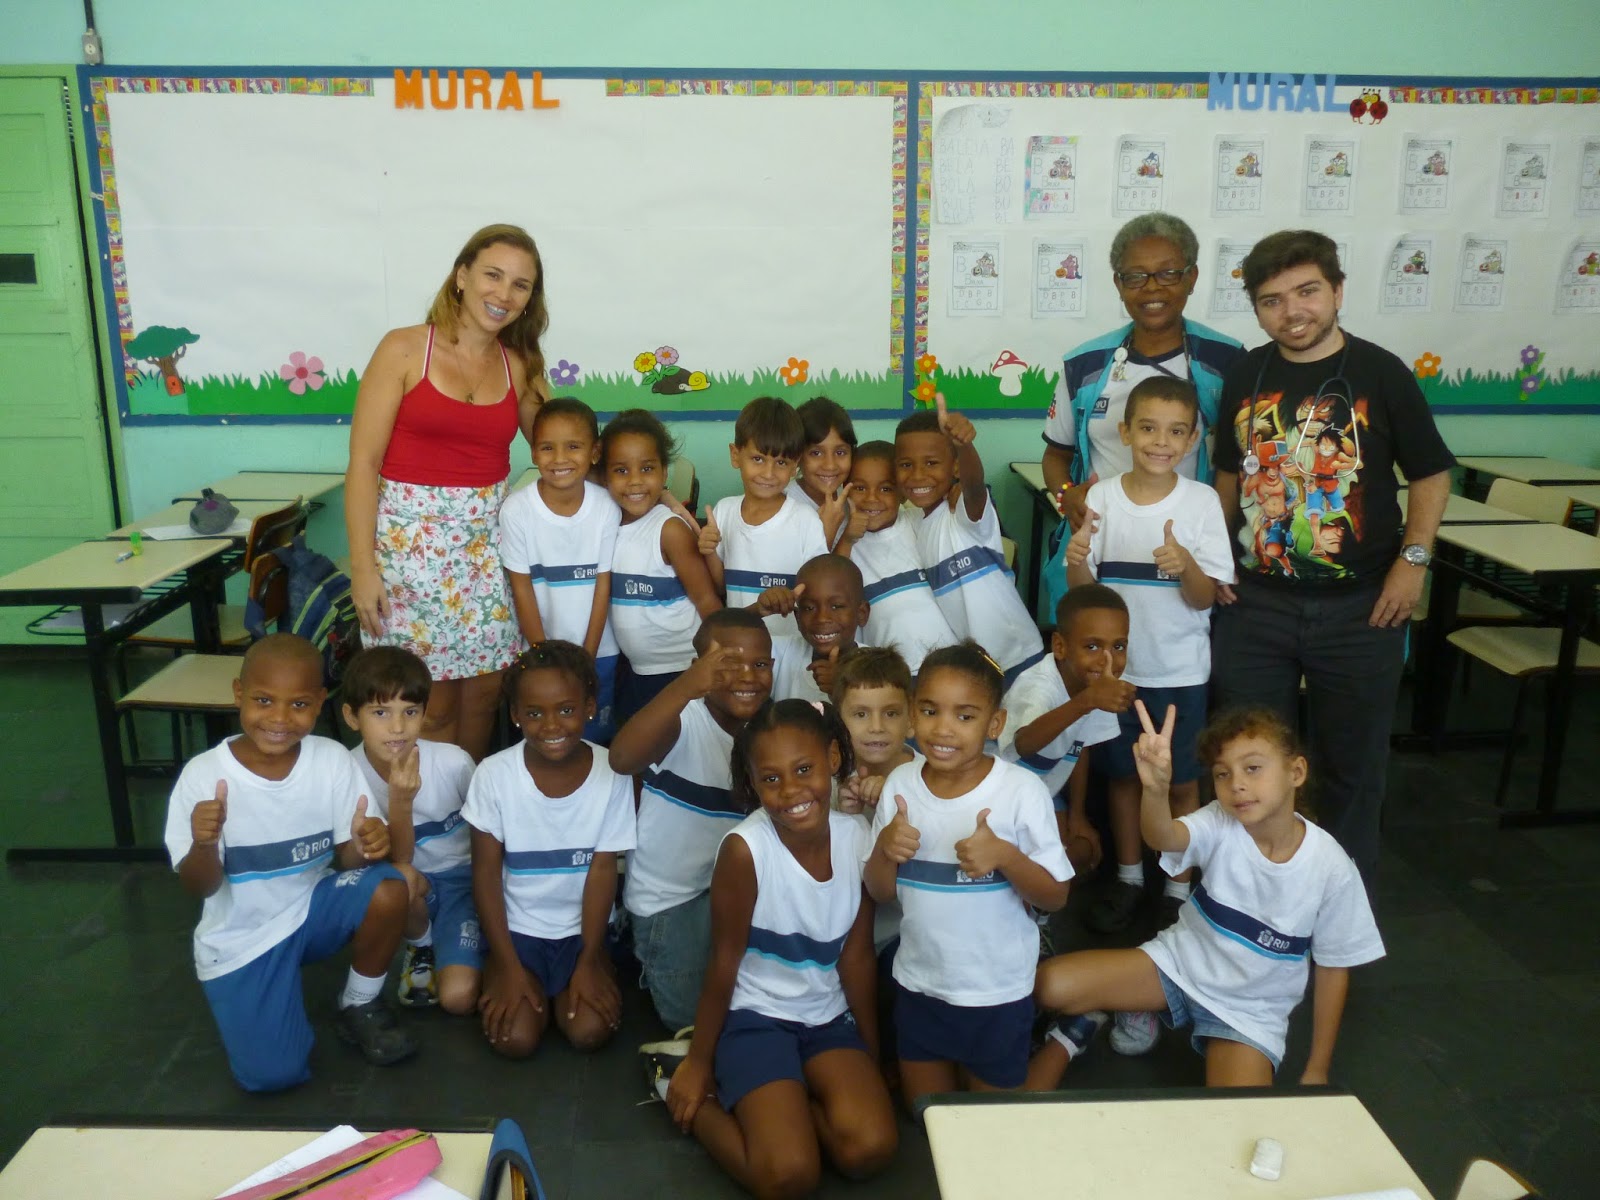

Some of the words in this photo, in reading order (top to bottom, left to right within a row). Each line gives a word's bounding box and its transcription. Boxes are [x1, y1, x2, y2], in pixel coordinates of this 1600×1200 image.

[394, 69, 560, 110] MURAL
[1208, 72, 1350, 112] MURAL
[1000, 137, 1015, 156] BA
[1122, 155, 1131, 172] B
[1221, 155, 1231, 172] B
[1311, 155, 1320, 172] B
[1409, 153, 1418, 170] B
[940, 176, 975, 194] BOLA
[995, 175, 1012, 193] BO
[955, 255, 965, 272] B
[1040, 257, 1050, 274] B
[638, 582, 653, 594] RIO
[772, 577, 787, 586] RIO
[312, 838, 330, 854] RIO
[460, 938, 478, 949] RIO
[1273, 938, 1290, 949] RIO
